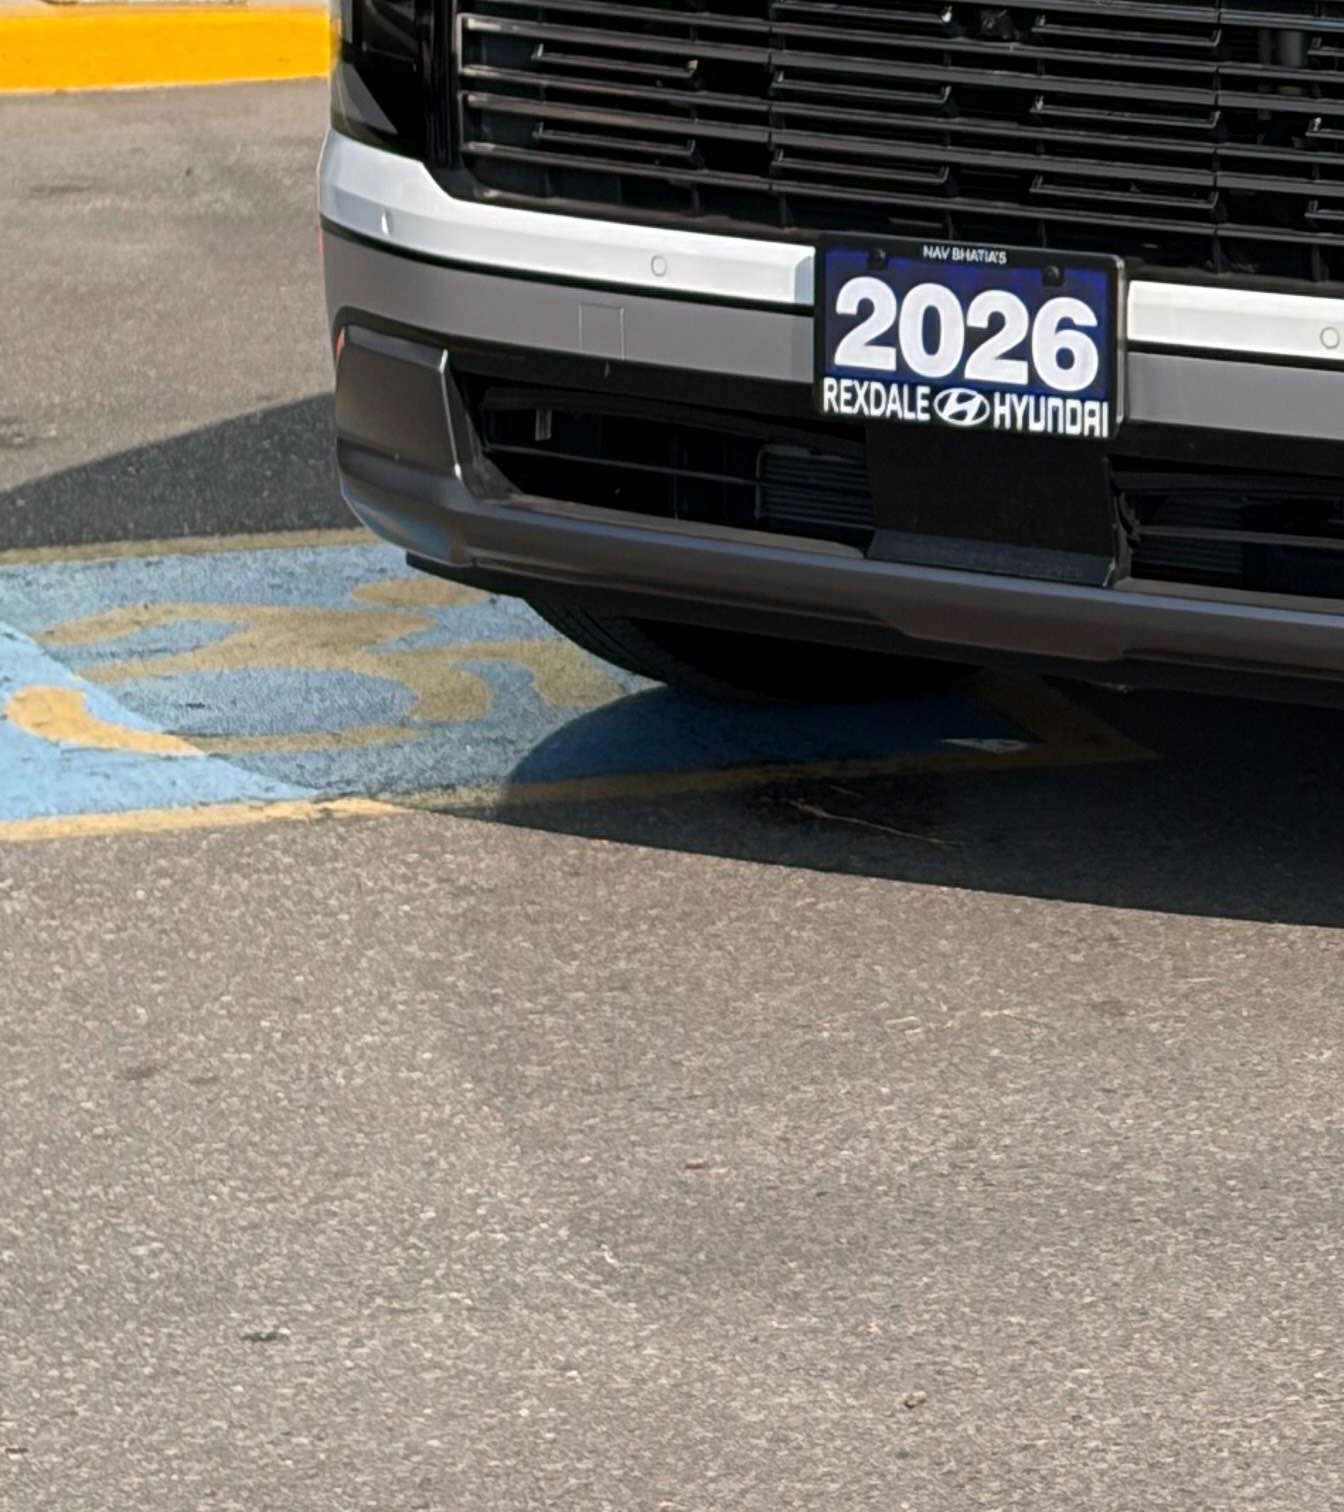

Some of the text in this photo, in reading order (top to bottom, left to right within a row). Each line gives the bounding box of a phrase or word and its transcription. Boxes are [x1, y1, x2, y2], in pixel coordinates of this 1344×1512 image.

[923, 245, 1007, 264] NAV BHATIA'S
[834, 276, 1099, 391] 2026
[823, 377, 1108, 437] REXDALE HYUNDAI
